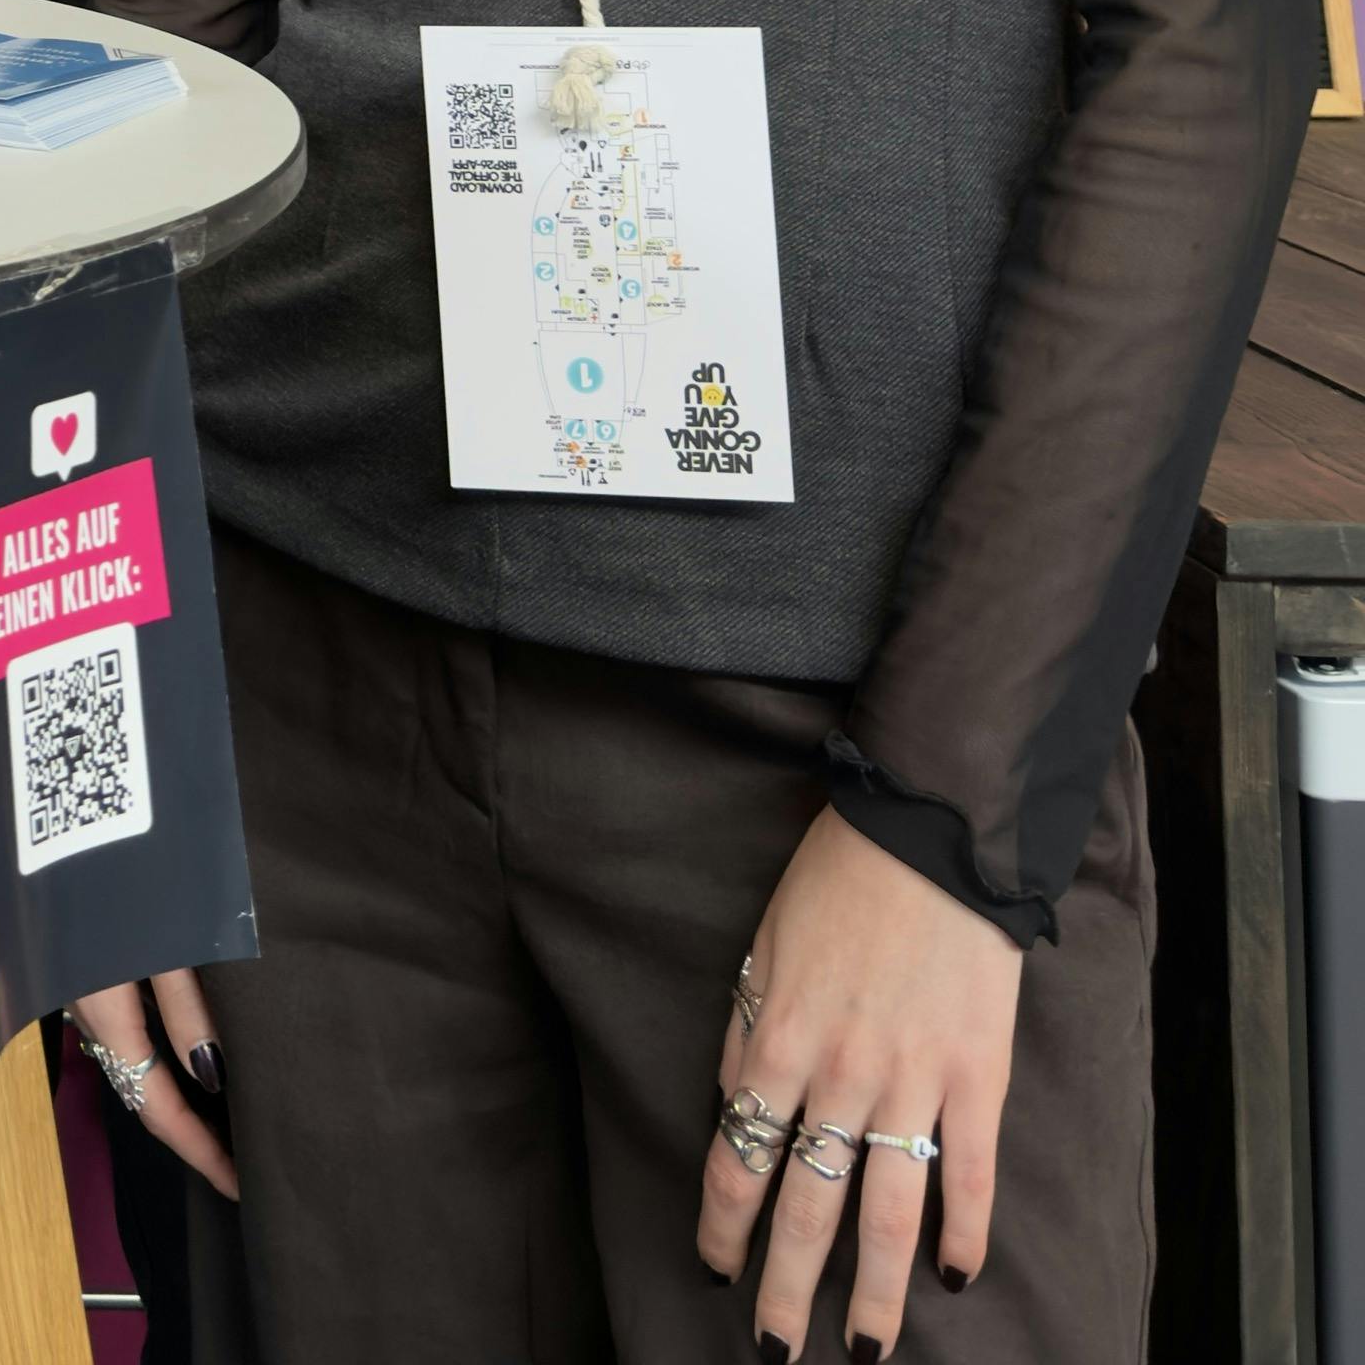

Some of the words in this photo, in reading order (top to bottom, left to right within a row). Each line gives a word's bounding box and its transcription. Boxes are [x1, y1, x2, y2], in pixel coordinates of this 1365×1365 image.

[448, 171, 500, 182] OFFICIAL
[501, 171, 523, 182] THE
[450, 182, 523, 194] DOWNLOAD
[625, 282, 637, 298] 5
[580, 362, 593, 389] 1
[691, 362, 726, 384] UP
[684, 407, 740, 429] GIVE
[664, 427, 762, 453] GONNA
[676, 450, 754, 475] NEVER
[1, 516, 71, 578] ALLES
[76, 502, 121, 555] AUF
[60, 556, 143, 617] KLICK:
